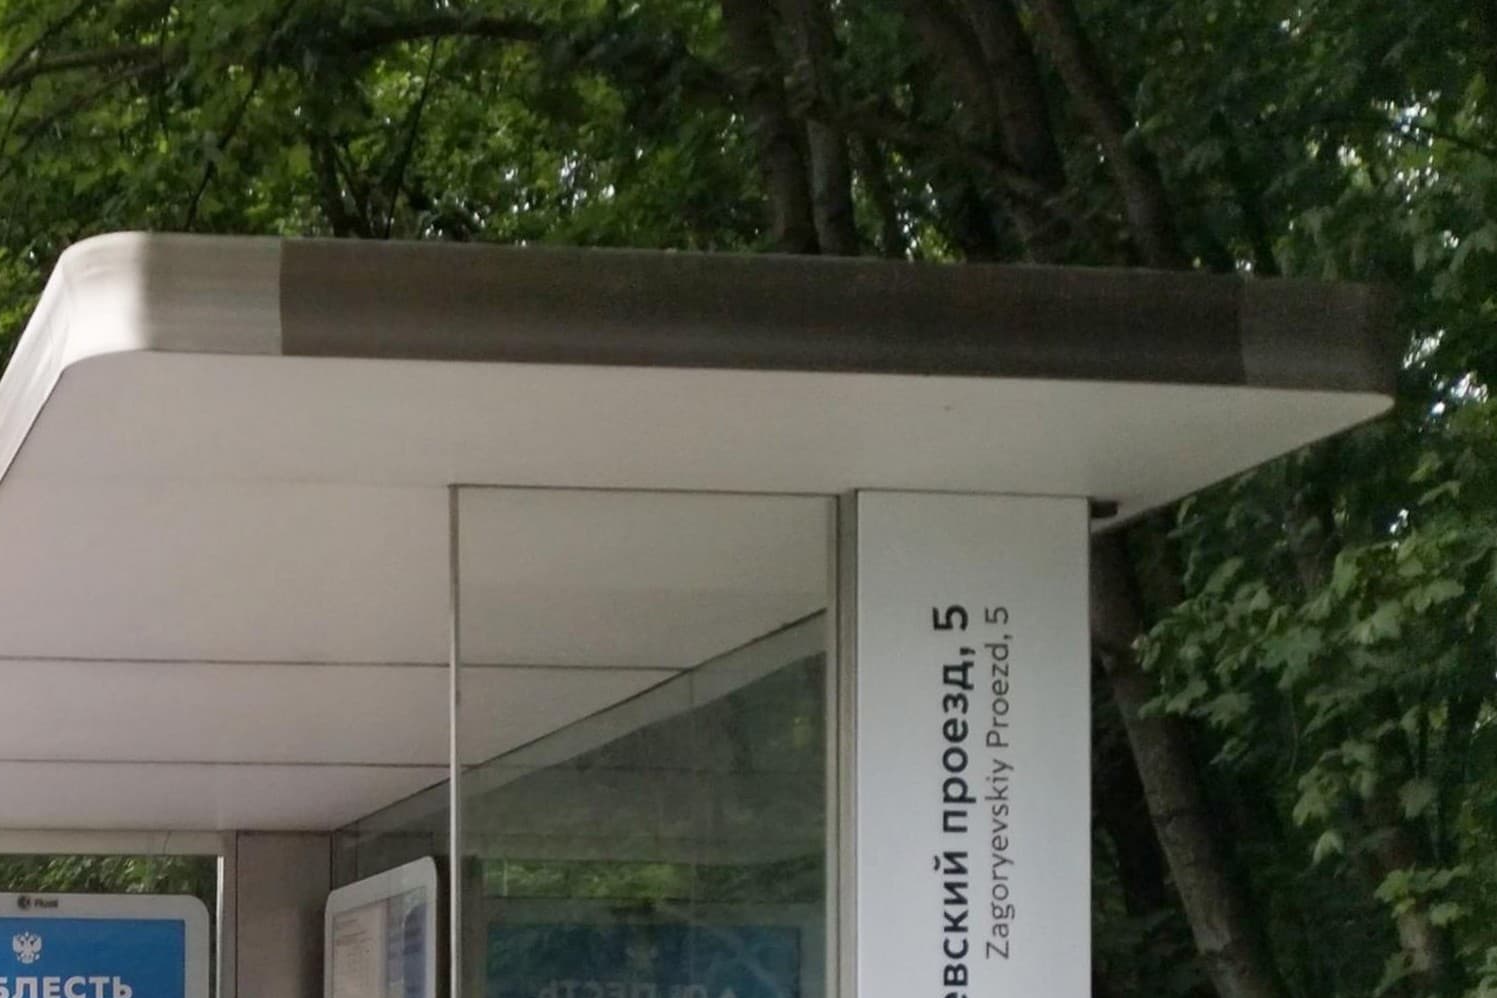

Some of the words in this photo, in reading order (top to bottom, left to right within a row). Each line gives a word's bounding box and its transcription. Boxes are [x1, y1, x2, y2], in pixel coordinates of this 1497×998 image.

[932, 604, 969, 631] 5
[984, 606, 1009, 625] 5
[942, 646, 977, 833] проезд,
[985, 633, 1013, 748] Proezd,
[986, 758, 1015, 960] Zagoryevskiy
